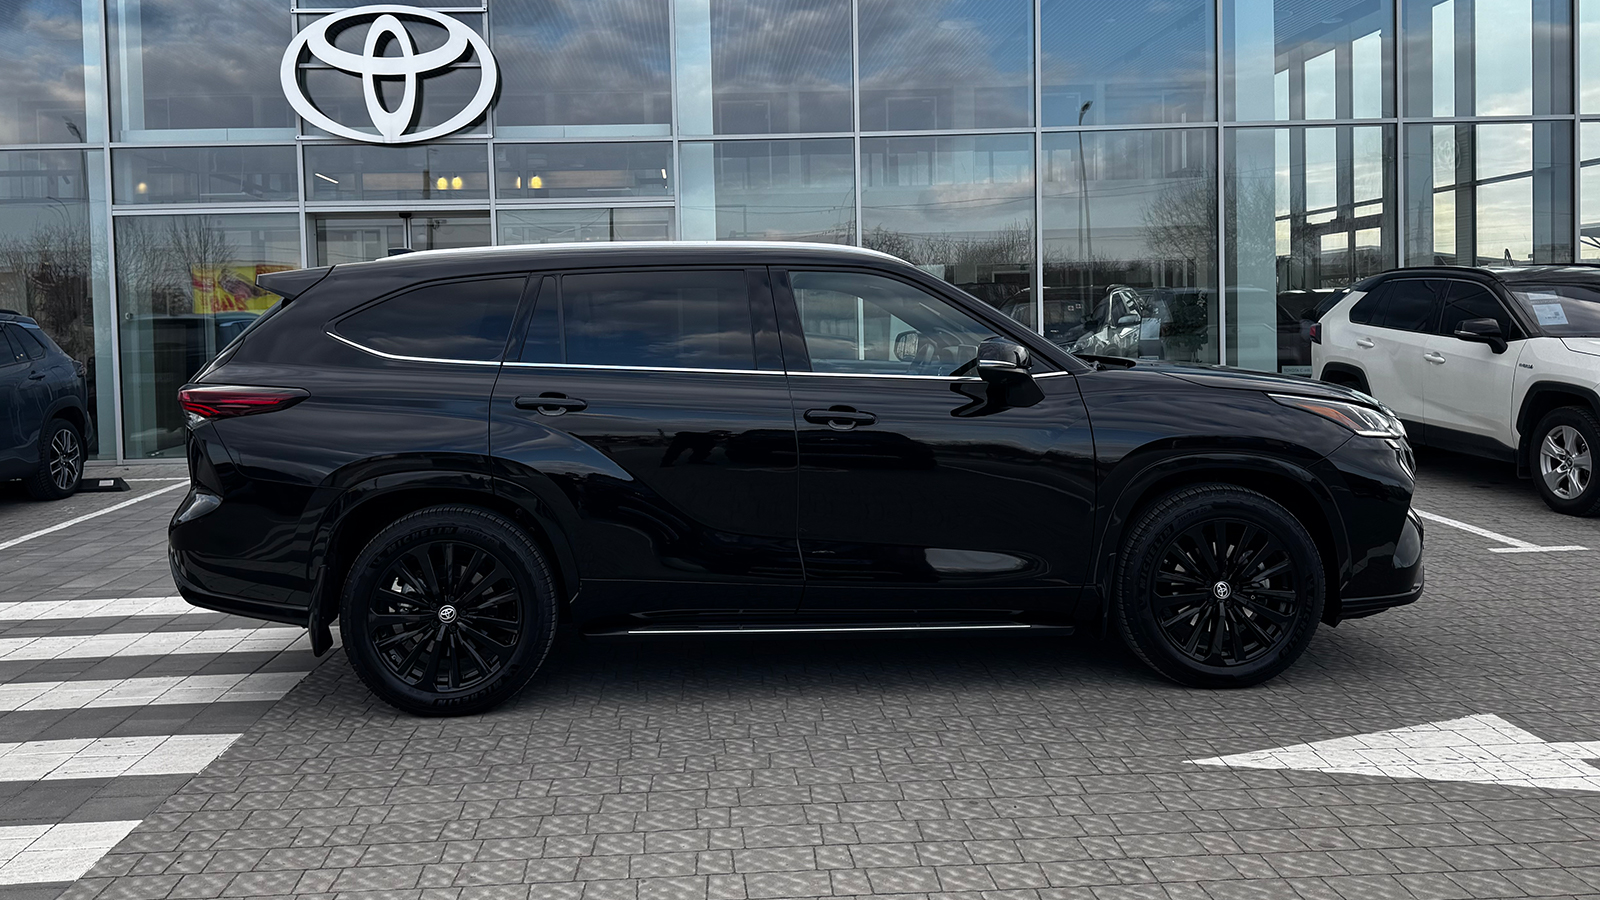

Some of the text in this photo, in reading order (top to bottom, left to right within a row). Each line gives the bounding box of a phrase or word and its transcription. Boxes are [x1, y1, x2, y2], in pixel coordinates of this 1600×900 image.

[386, 527, 455, 554] MICHELIN
[1139, 525, 1172, 589] MICHELIN
[1281, 595, 1313, 657] MICHELIN
[437, 678, 503, 706] MICHELIN
